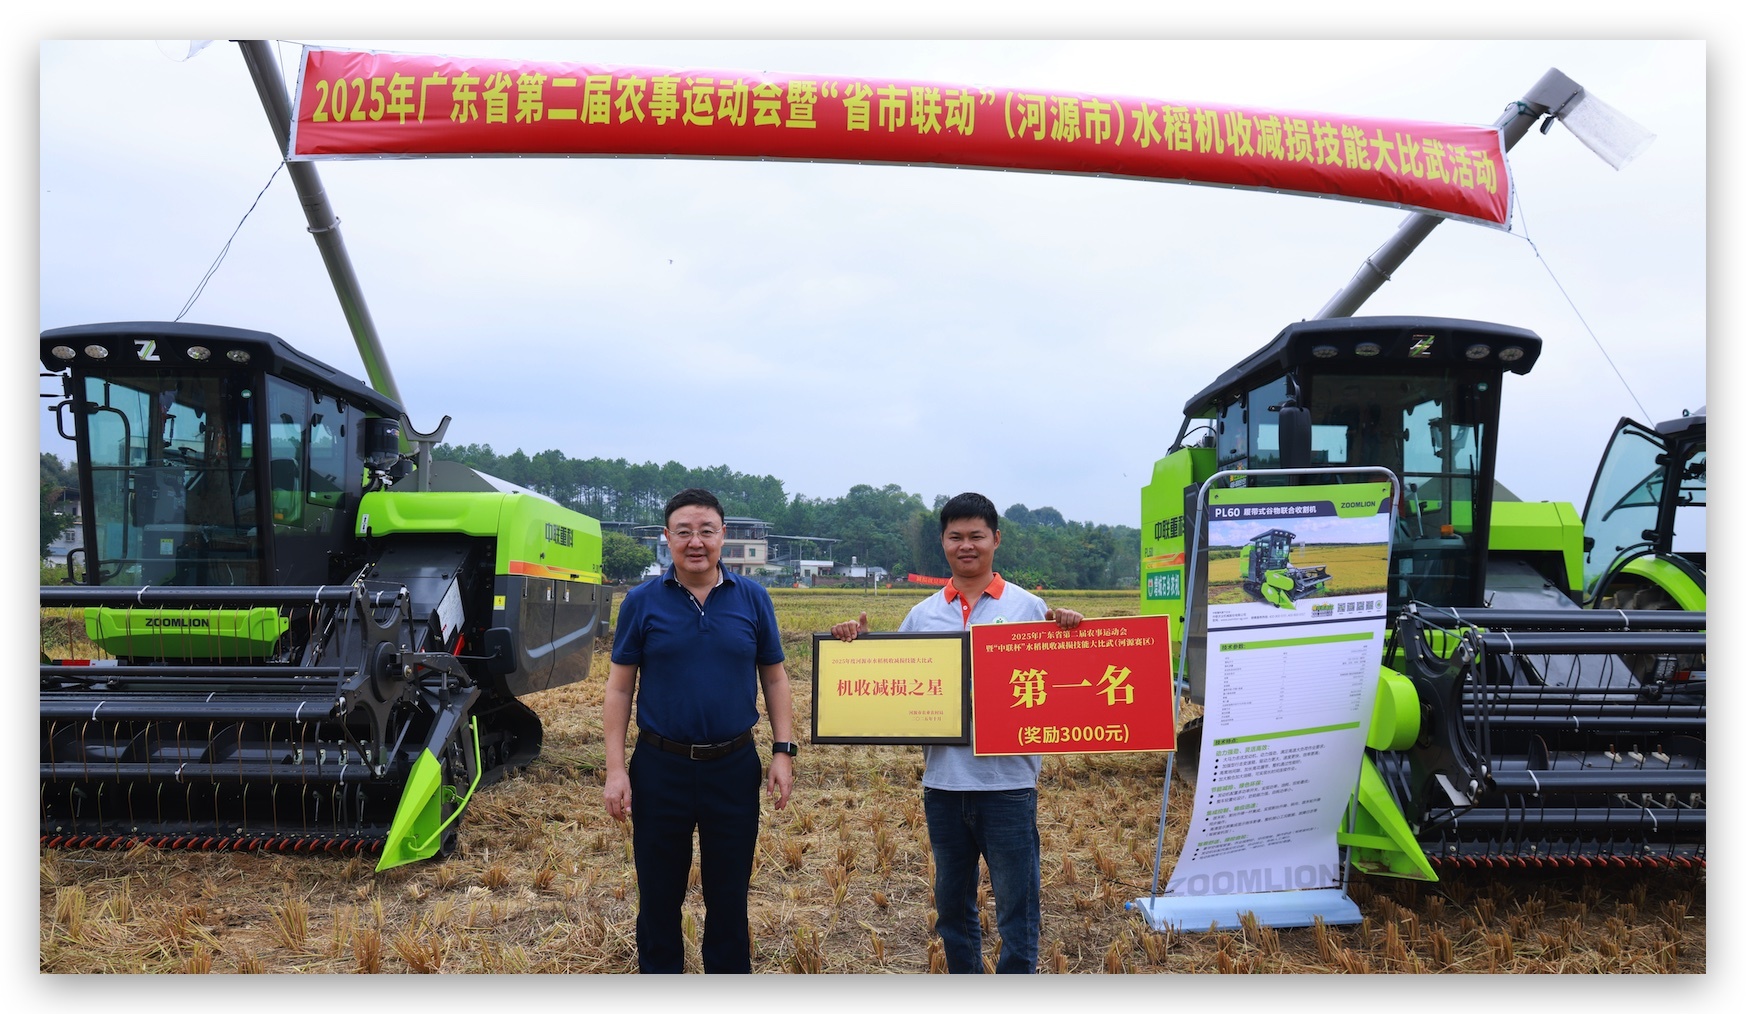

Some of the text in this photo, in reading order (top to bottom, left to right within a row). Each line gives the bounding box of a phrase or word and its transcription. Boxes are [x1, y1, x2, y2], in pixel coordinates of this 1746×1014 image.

[1214, 505, 1317, 518] PL60 履带式谷物联合收割机
[1340, 501, 1376, 509] ZOOMLION
[545, 522, 574, 548] 中联重科
[145, 618, 209, 627] ZOOMLION
[1011, 627, 1128, 641] 2025年广东省第二届农事运动会
[836, 678, 943, 697] 机收减损之星
[1009, 664, 1135, 709] 第一名
